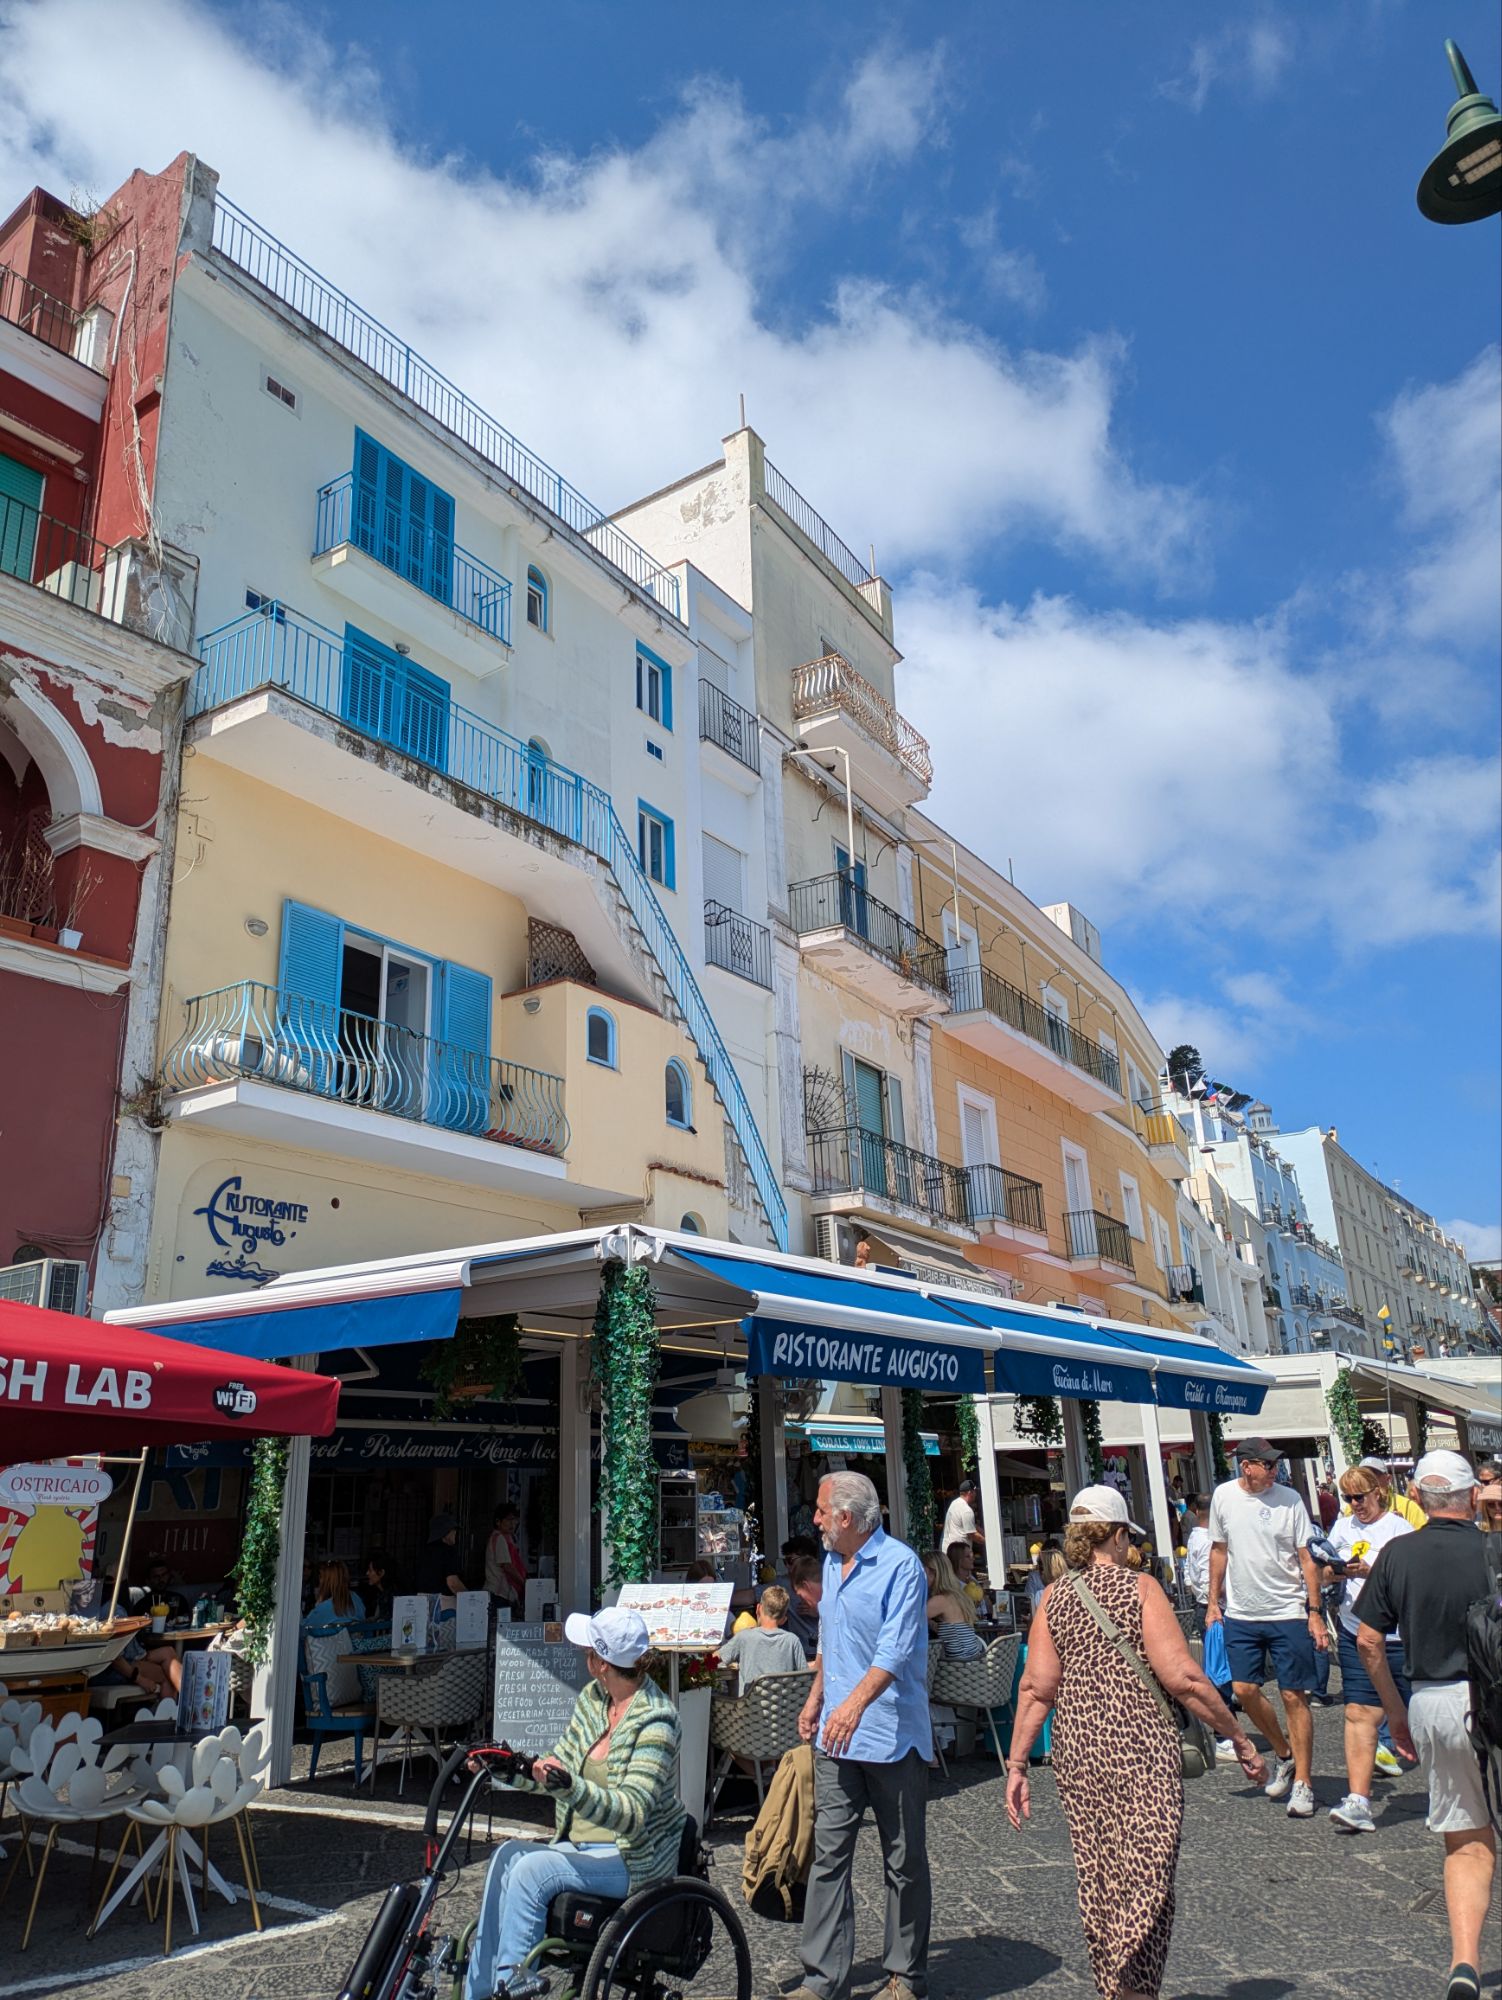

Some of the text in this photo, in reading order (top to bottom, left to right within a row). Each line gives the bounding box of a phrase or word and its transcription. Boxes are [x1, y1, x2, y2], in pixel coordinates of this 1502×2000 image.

[226, 1193, 308, 1222] RISTORANTE
[773, 1331, 959, 1382] RISTORANTE AUGUSTO
[64, 1363, 152, 1409] LAB
[360, 1433, 464, 1459] Restaurant
[11, 1476, 100, 1493] OSTRICAIO
[499, 1683, 527, 1695] FRESH
